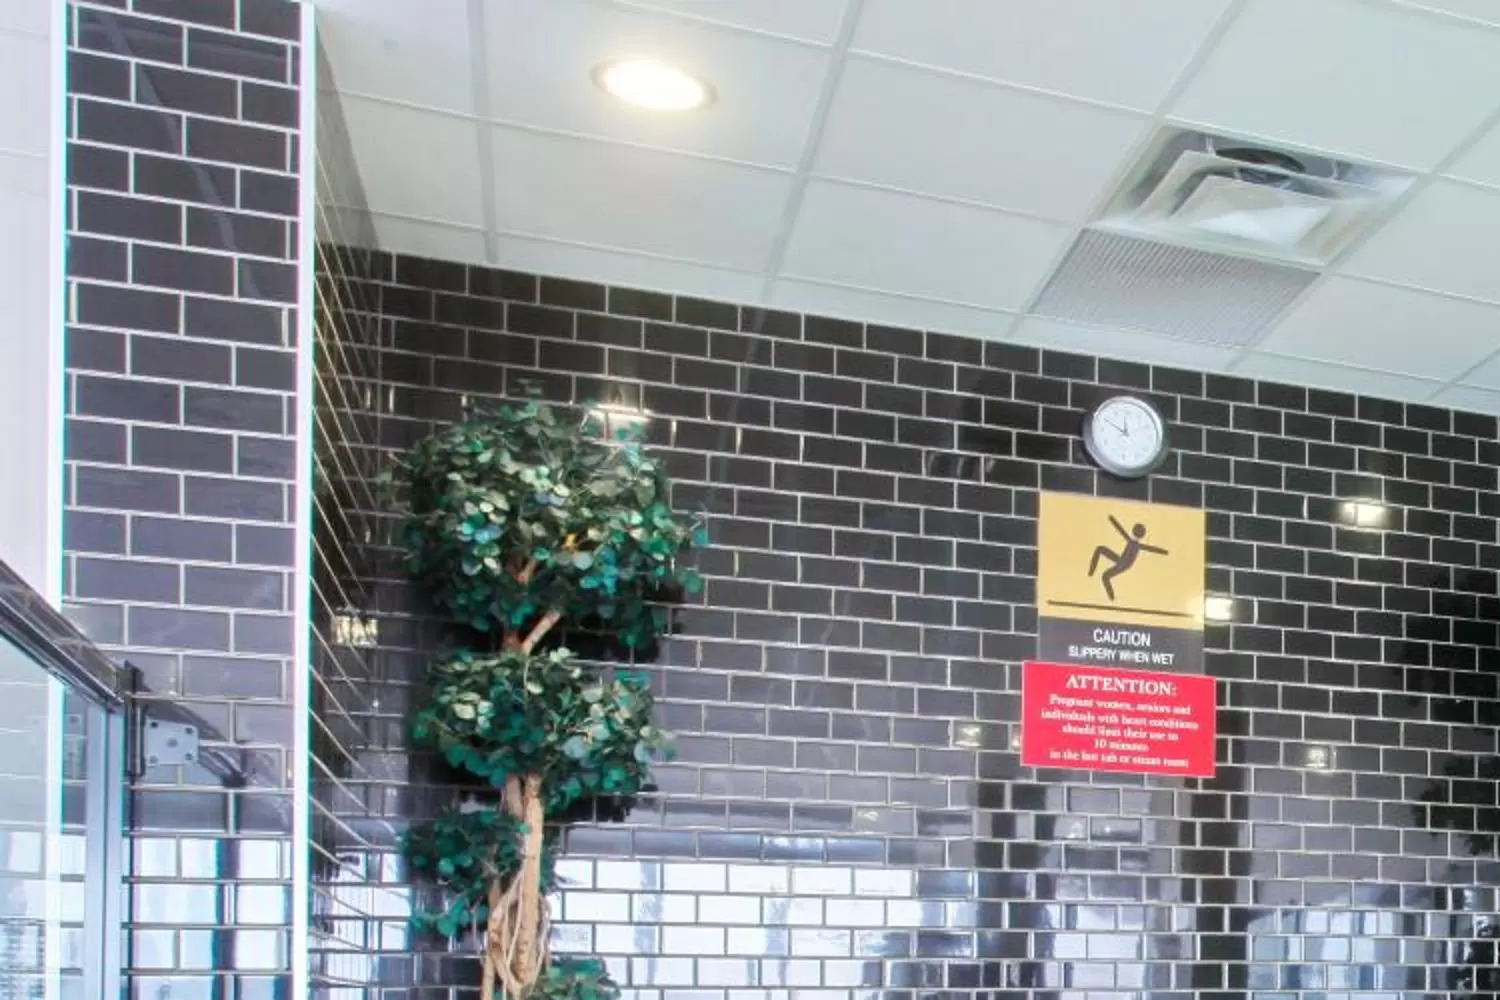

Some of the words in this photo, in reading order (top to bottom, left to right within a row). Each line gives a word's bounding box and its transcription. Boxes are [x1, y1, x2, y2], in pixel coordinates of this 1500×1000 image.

[1093, 629, 1151, 647] CAUTION
[1068, 645, 1116, 660] SLIPPERY
[1119, 650, 1150, 663] WHEN
[1151, 653, 1175, 665] WET
[1066, 674, 1177, 696] ATTENTION:
[1049, 693, 1093, 708] Pregnant
[1172, 704, 1191, 715] and
[1041, 707, 1095, 722] individuals
[1097, 712, 1119, 724] with
[1121, 714, 1146, 726] heart
[1148, 718, 1199, 730] conditions
[1062, 722, 1096, 735] should
[1063, 749, 1080, 761] the
